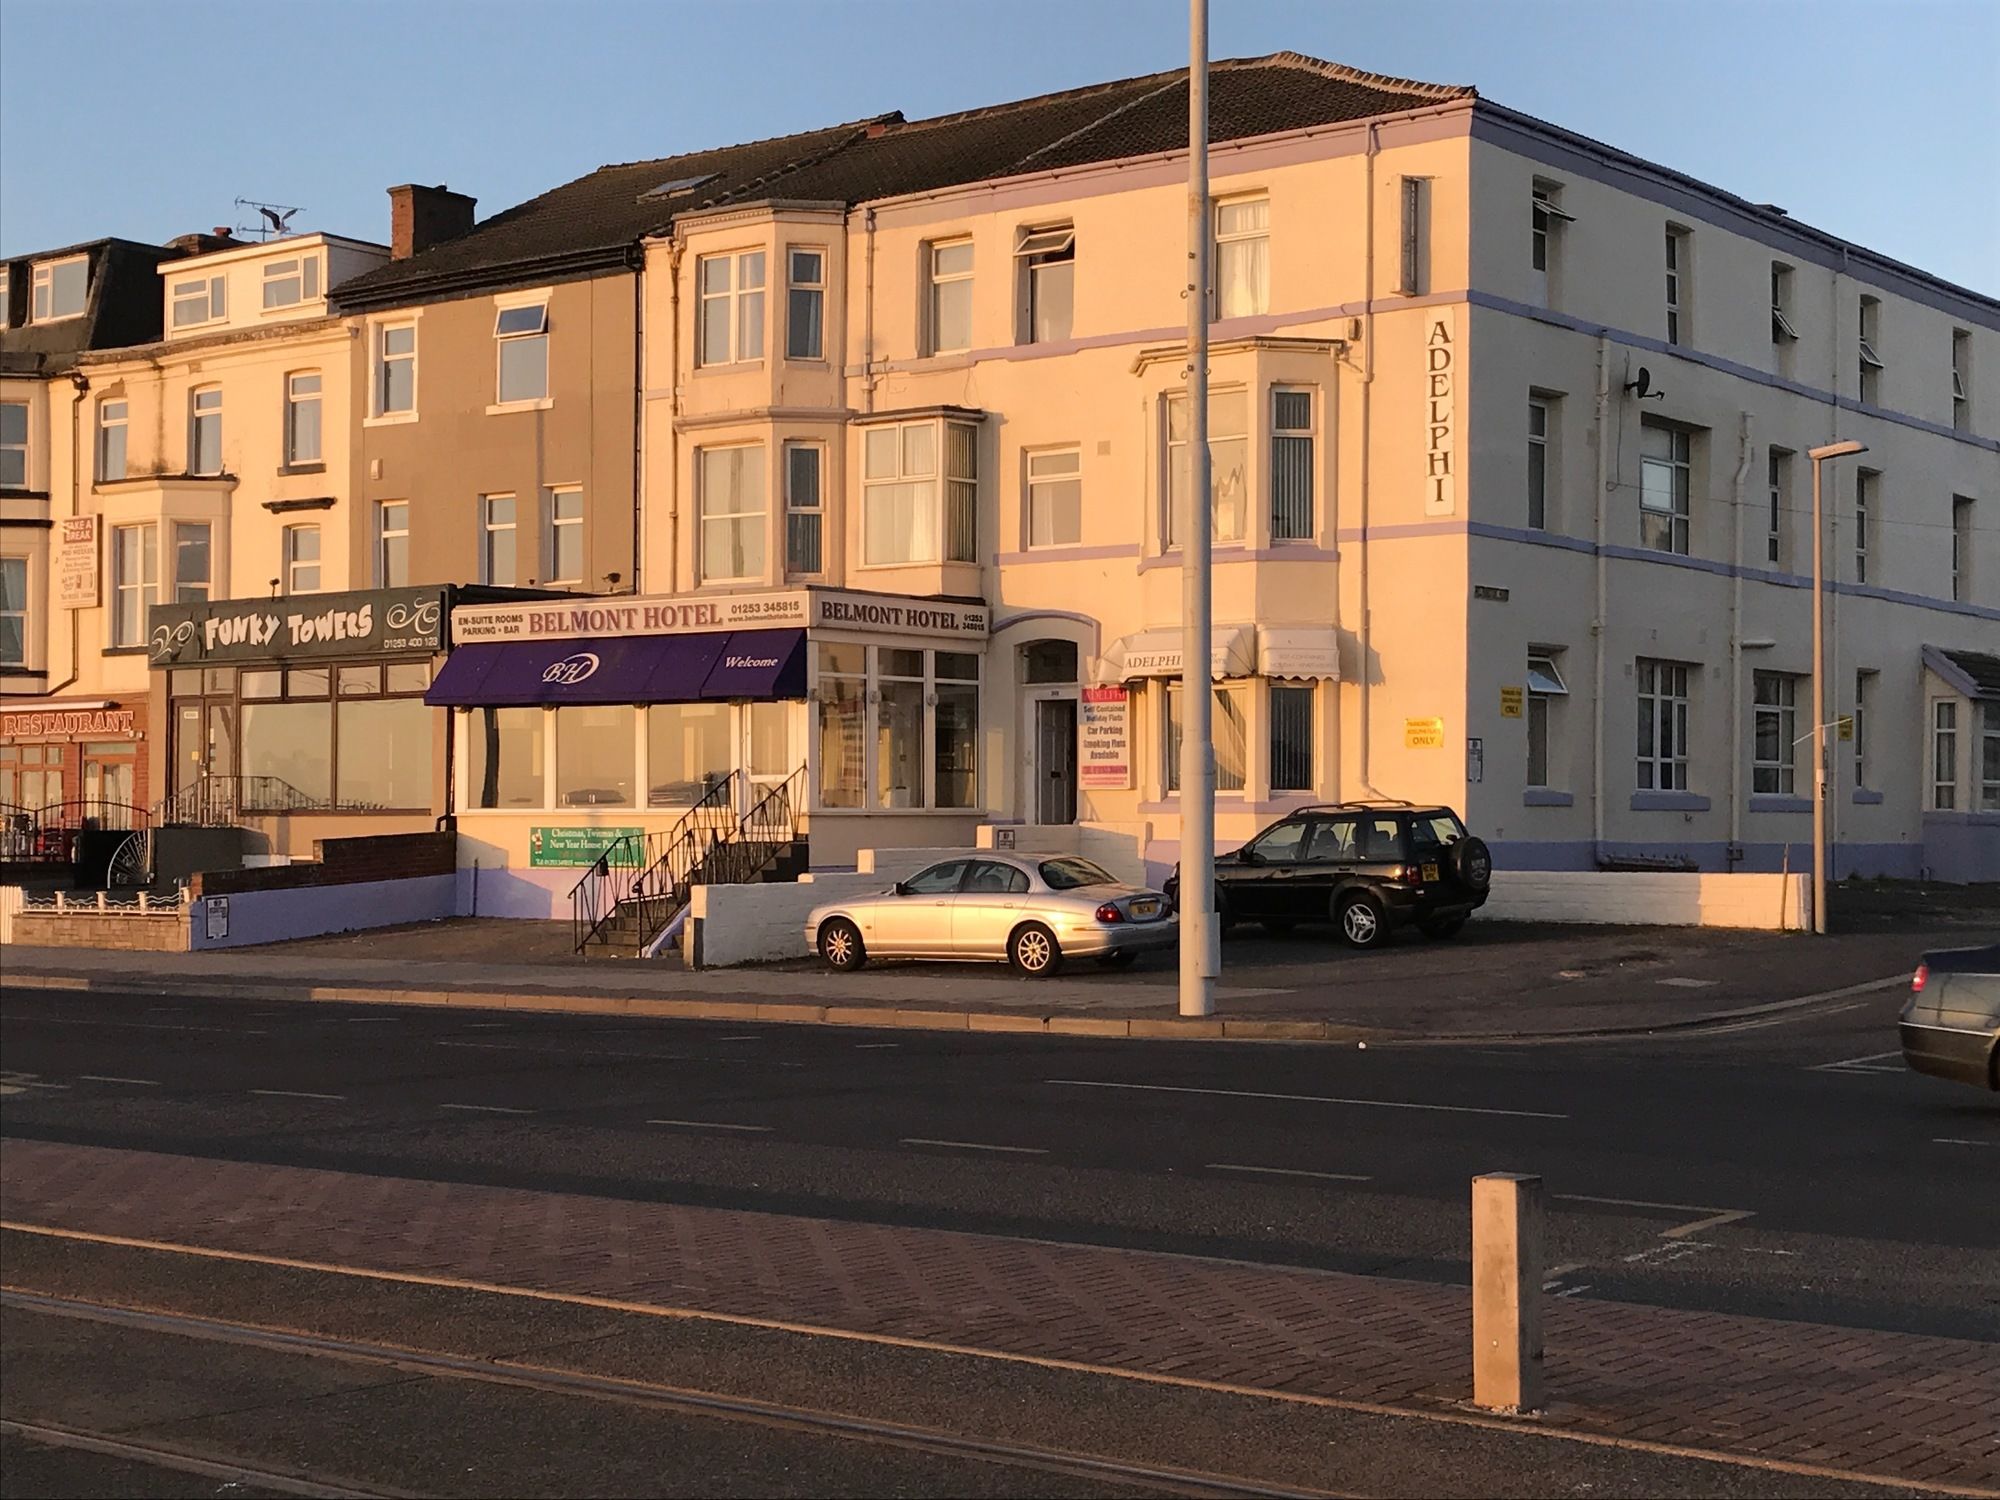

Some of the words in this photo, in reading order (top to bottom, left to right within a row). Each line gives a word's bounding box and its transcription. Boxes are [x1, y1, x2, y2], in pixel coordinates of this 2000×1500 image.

[1428, 321, 1451, 502] ADELPHI
[66, 530, 91, 541] BREAK
[731, 603, 761, 614] 01253
[763, 600, 799, 613] 345815
[458, 615, 493, 626] EN-SUITE
[495, 614, 524, 624] ROOMS
[528, 608, 637, 635] BELMONT
[643, 603, 723, 630] HOTEL
[821, 601, 903, 626] BELMONT
[906, 608, 959, 630] HOTEL
[204, 612, 281, 650] FUNKY
[287, 603, 374, 646] TOWERS
[462, 627, 496, 636] PARKING
[503, 626, 520, 634] BAR
[408, 637, 423, 648] 400
[424, 636, 438, 647] 123
[725, 655, 779, 668] Welcome
[1126, 655, 1182, 668] ADELPHI
[3, 711, 134, 736] RESTAURANT
[1087, 726, 1098, 735] Car
[1099, 726, 1123, 736] Parking
[1412, 736, 1436, 745] ONLY
[549, 840, 566, 849] New
[566, 839, 580, 848] Year
[580, 839, 601, 849] House
